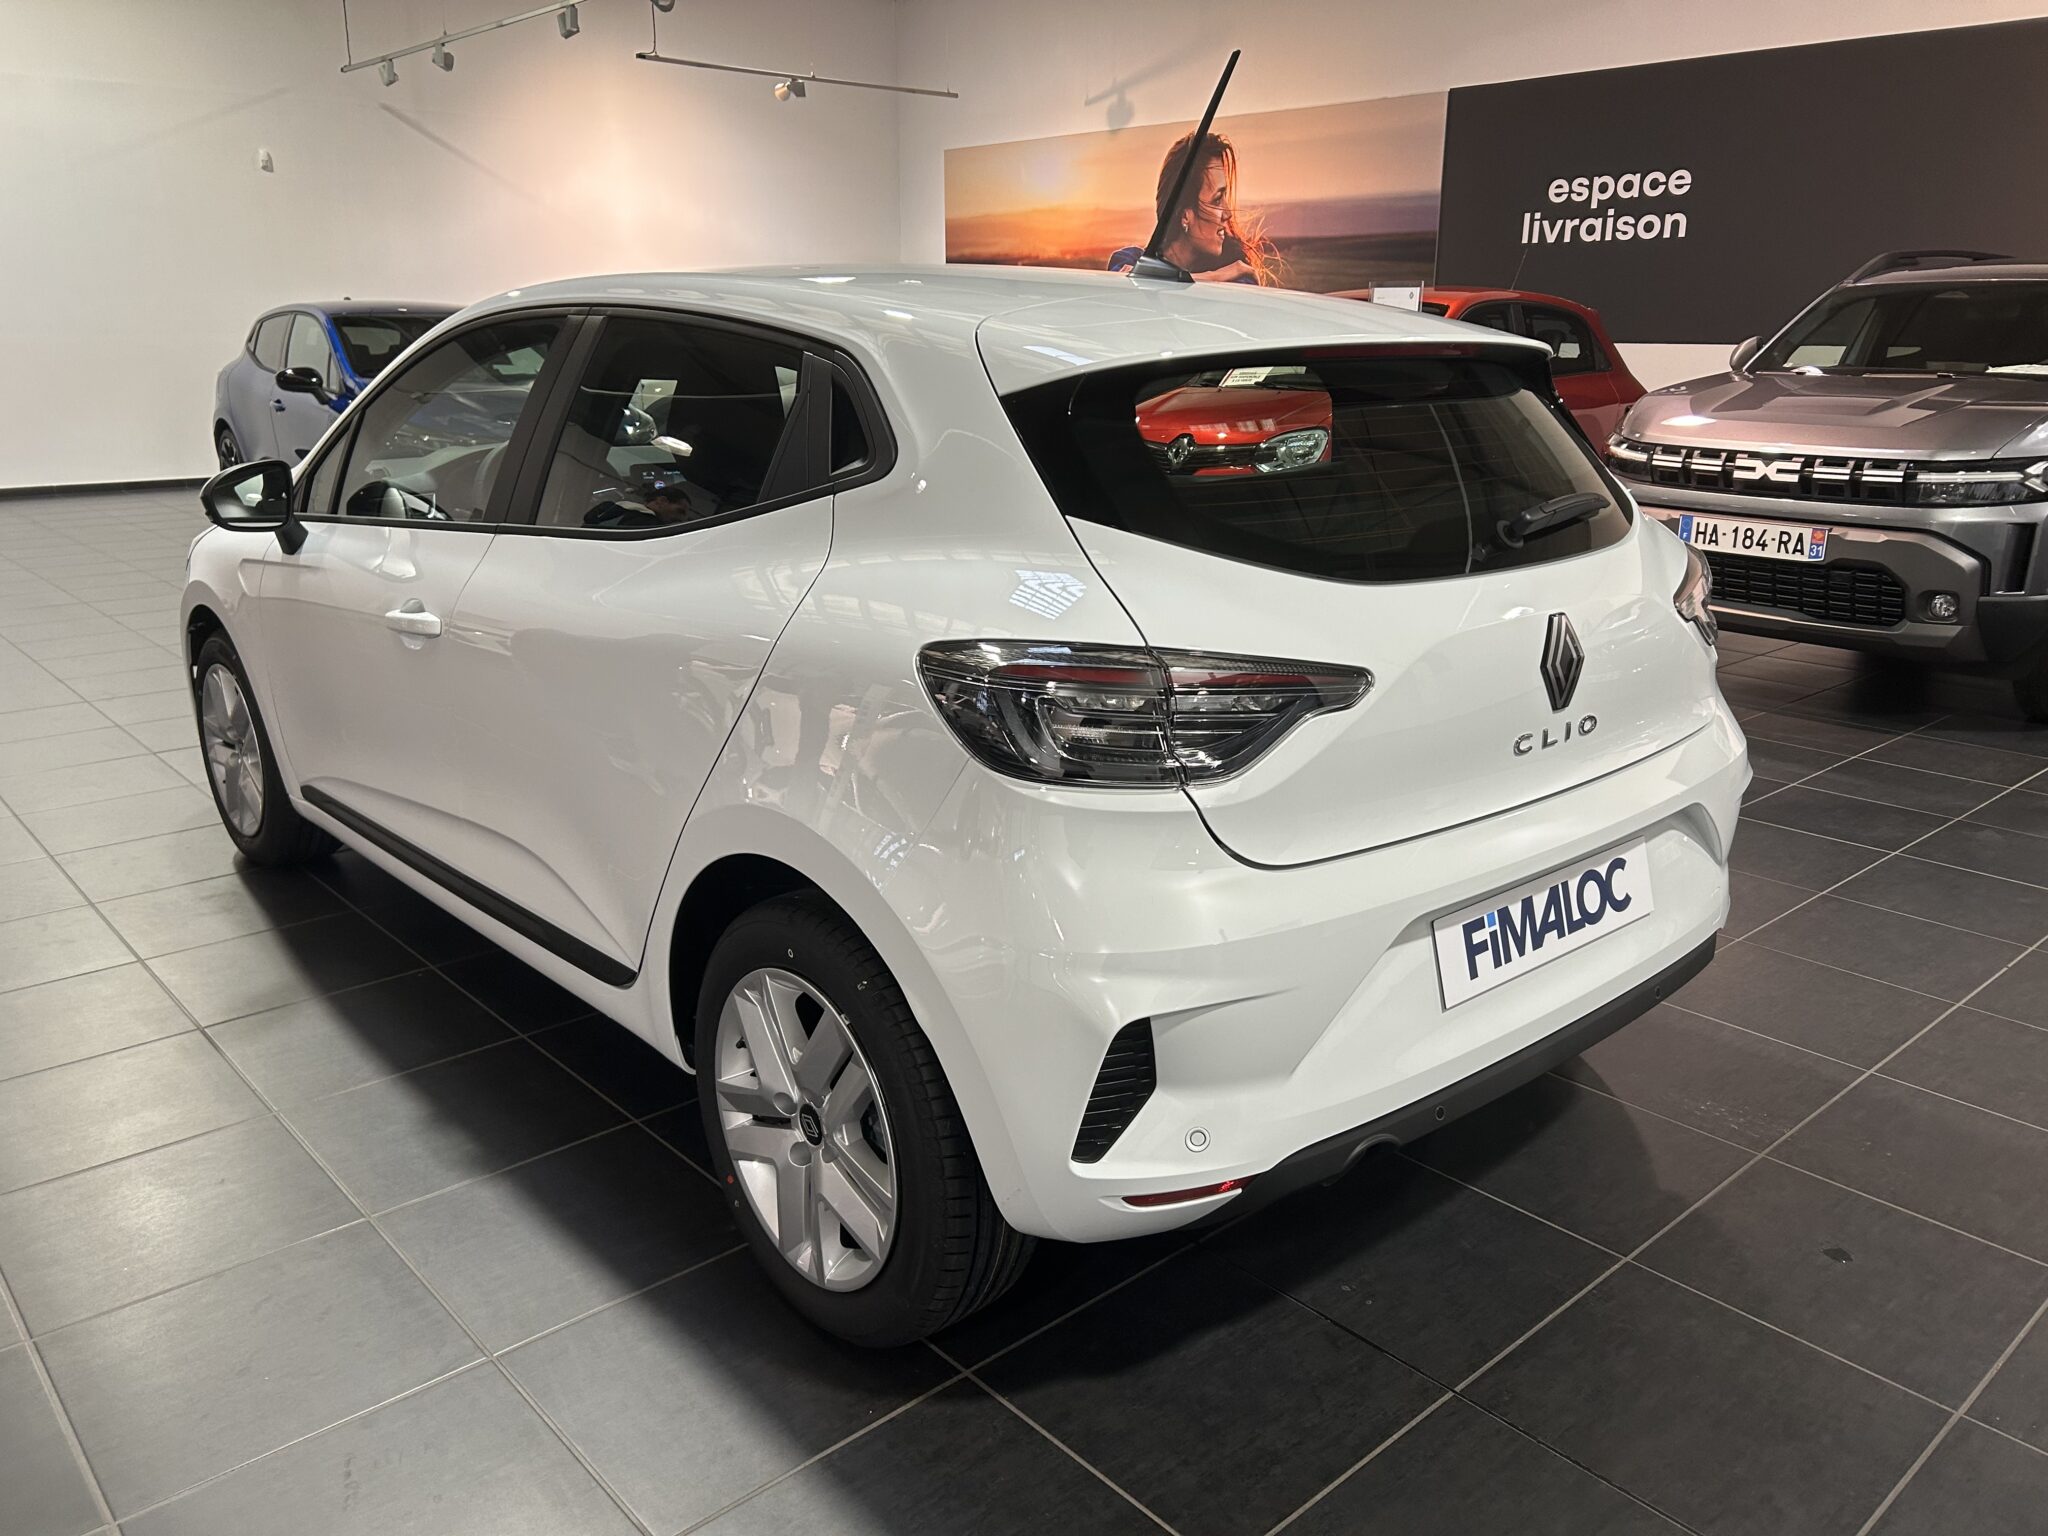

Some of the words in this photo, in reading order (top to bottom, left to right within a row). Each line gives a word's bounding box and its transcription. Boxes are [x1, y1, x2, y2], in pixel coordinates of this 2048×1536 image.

[1548, 169, 1692, 209] espace
[1521, 208, 1687, 244] livraison
[1694, 522, 1805, 556] HA-184-RA
[1810, 544, 1823, 557] 31
[1513, 714, 1597, 757] CLIO
